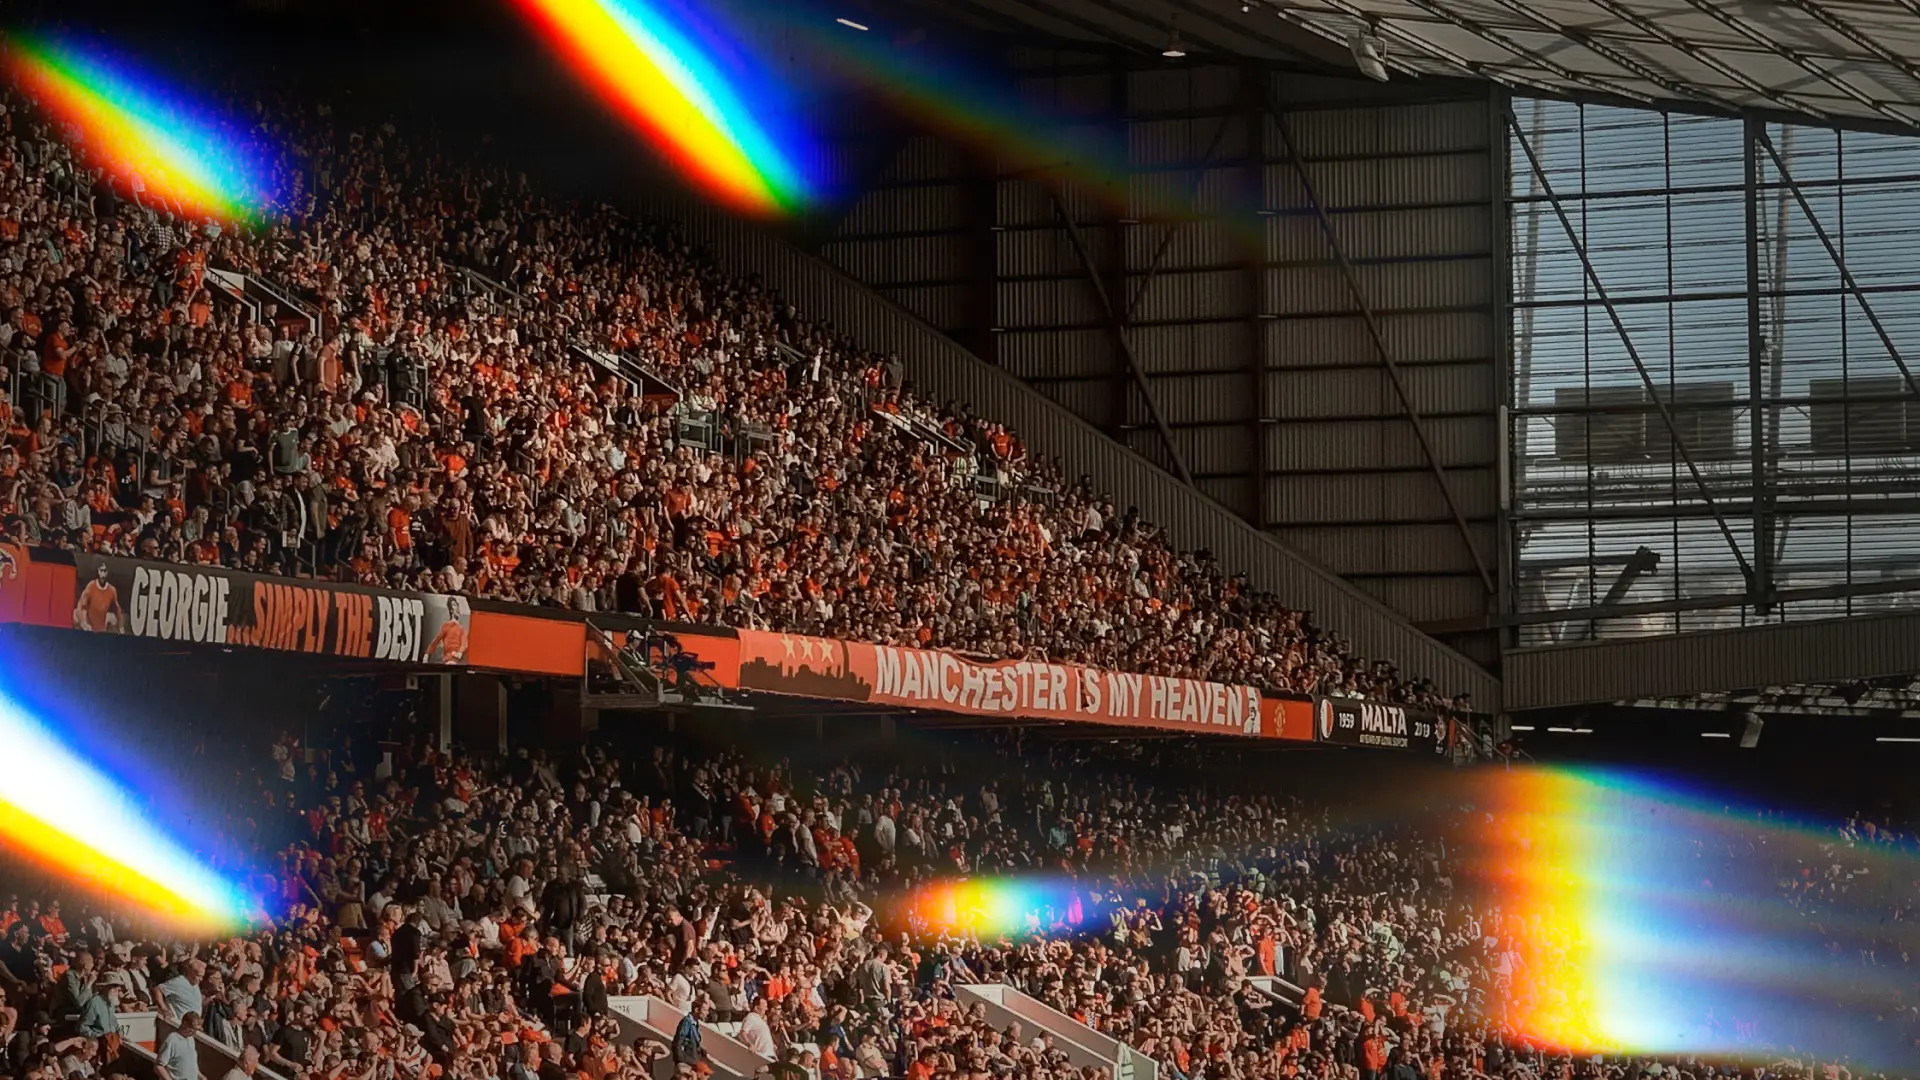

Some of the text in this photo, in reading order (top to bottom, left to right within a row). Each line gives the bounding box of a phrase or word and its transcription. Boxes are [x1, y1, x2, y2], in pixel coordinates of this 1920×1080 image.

[334, 591, 374, 658] THE
[375, 596, 425, 661] BEST
[875, 646, 1242, 726] MANCHESTER IS MY HEAVEN
[1360, 703, 1408, 736] MALTA
